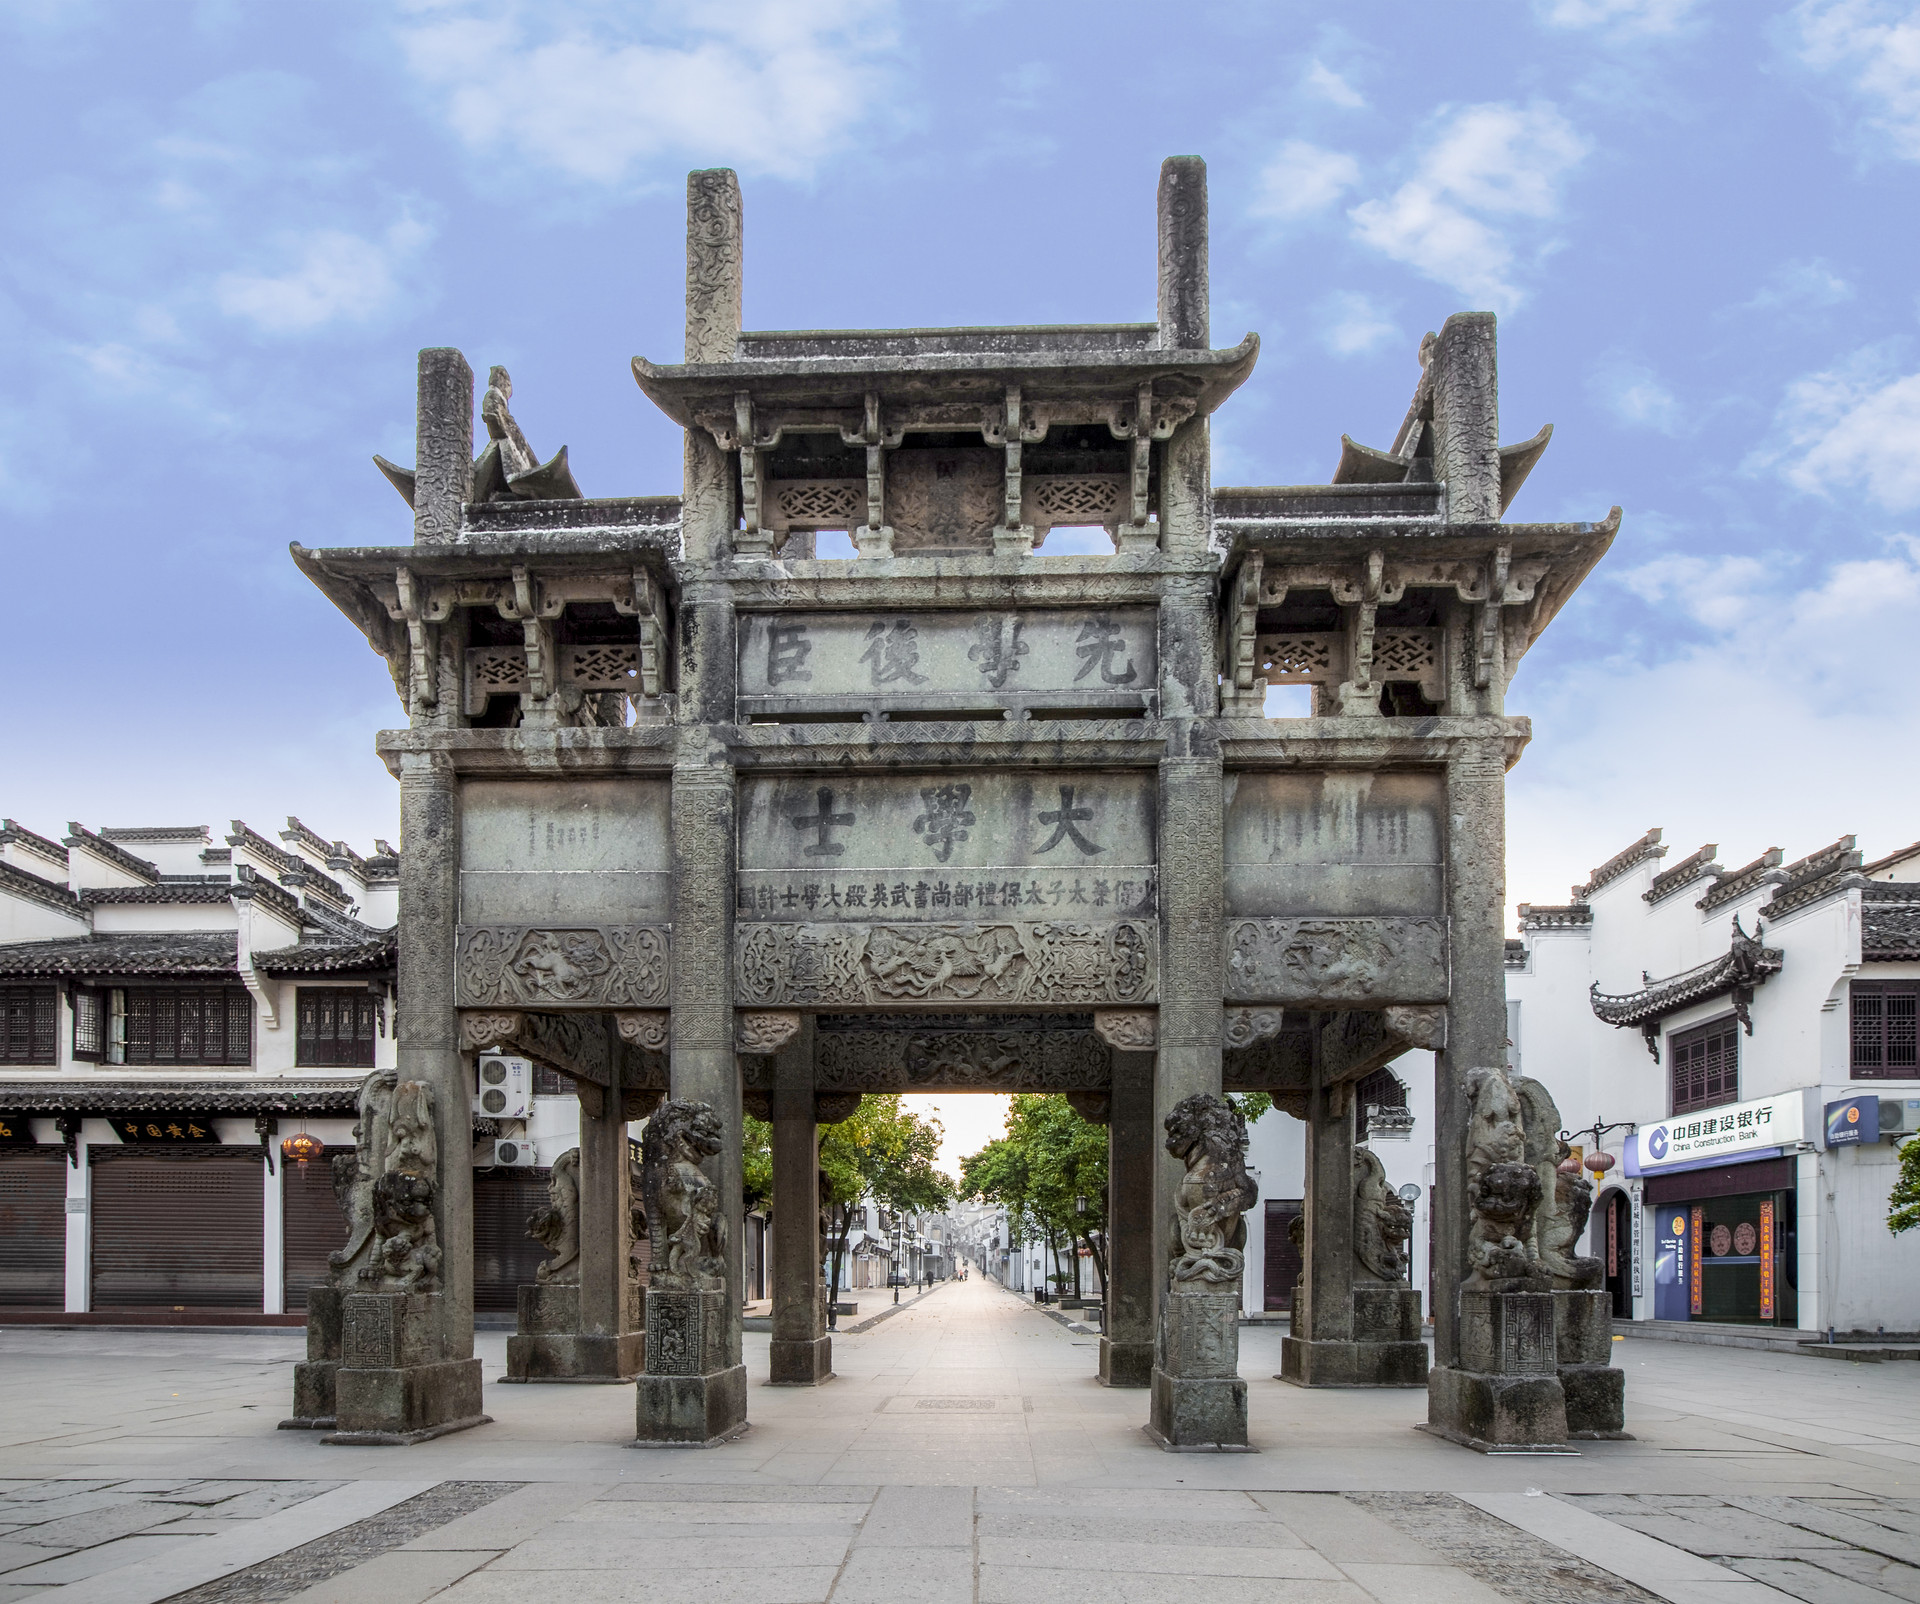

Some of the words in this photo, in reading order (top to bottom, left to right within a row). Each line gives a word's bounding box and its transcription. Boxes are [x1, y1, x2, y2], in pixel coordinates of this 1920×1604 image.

[792, 783, 1107, 863] 大學士
[124, 1122, 207, 1139] 中国黄金
[1673, 1106, 1773, 1141] 中国建设银行
[1673, 1141, 1691, 1152] China
[1694, 1134, 1736, 1149] Construction
[1739, 1129, 1758, 1141] Bank
